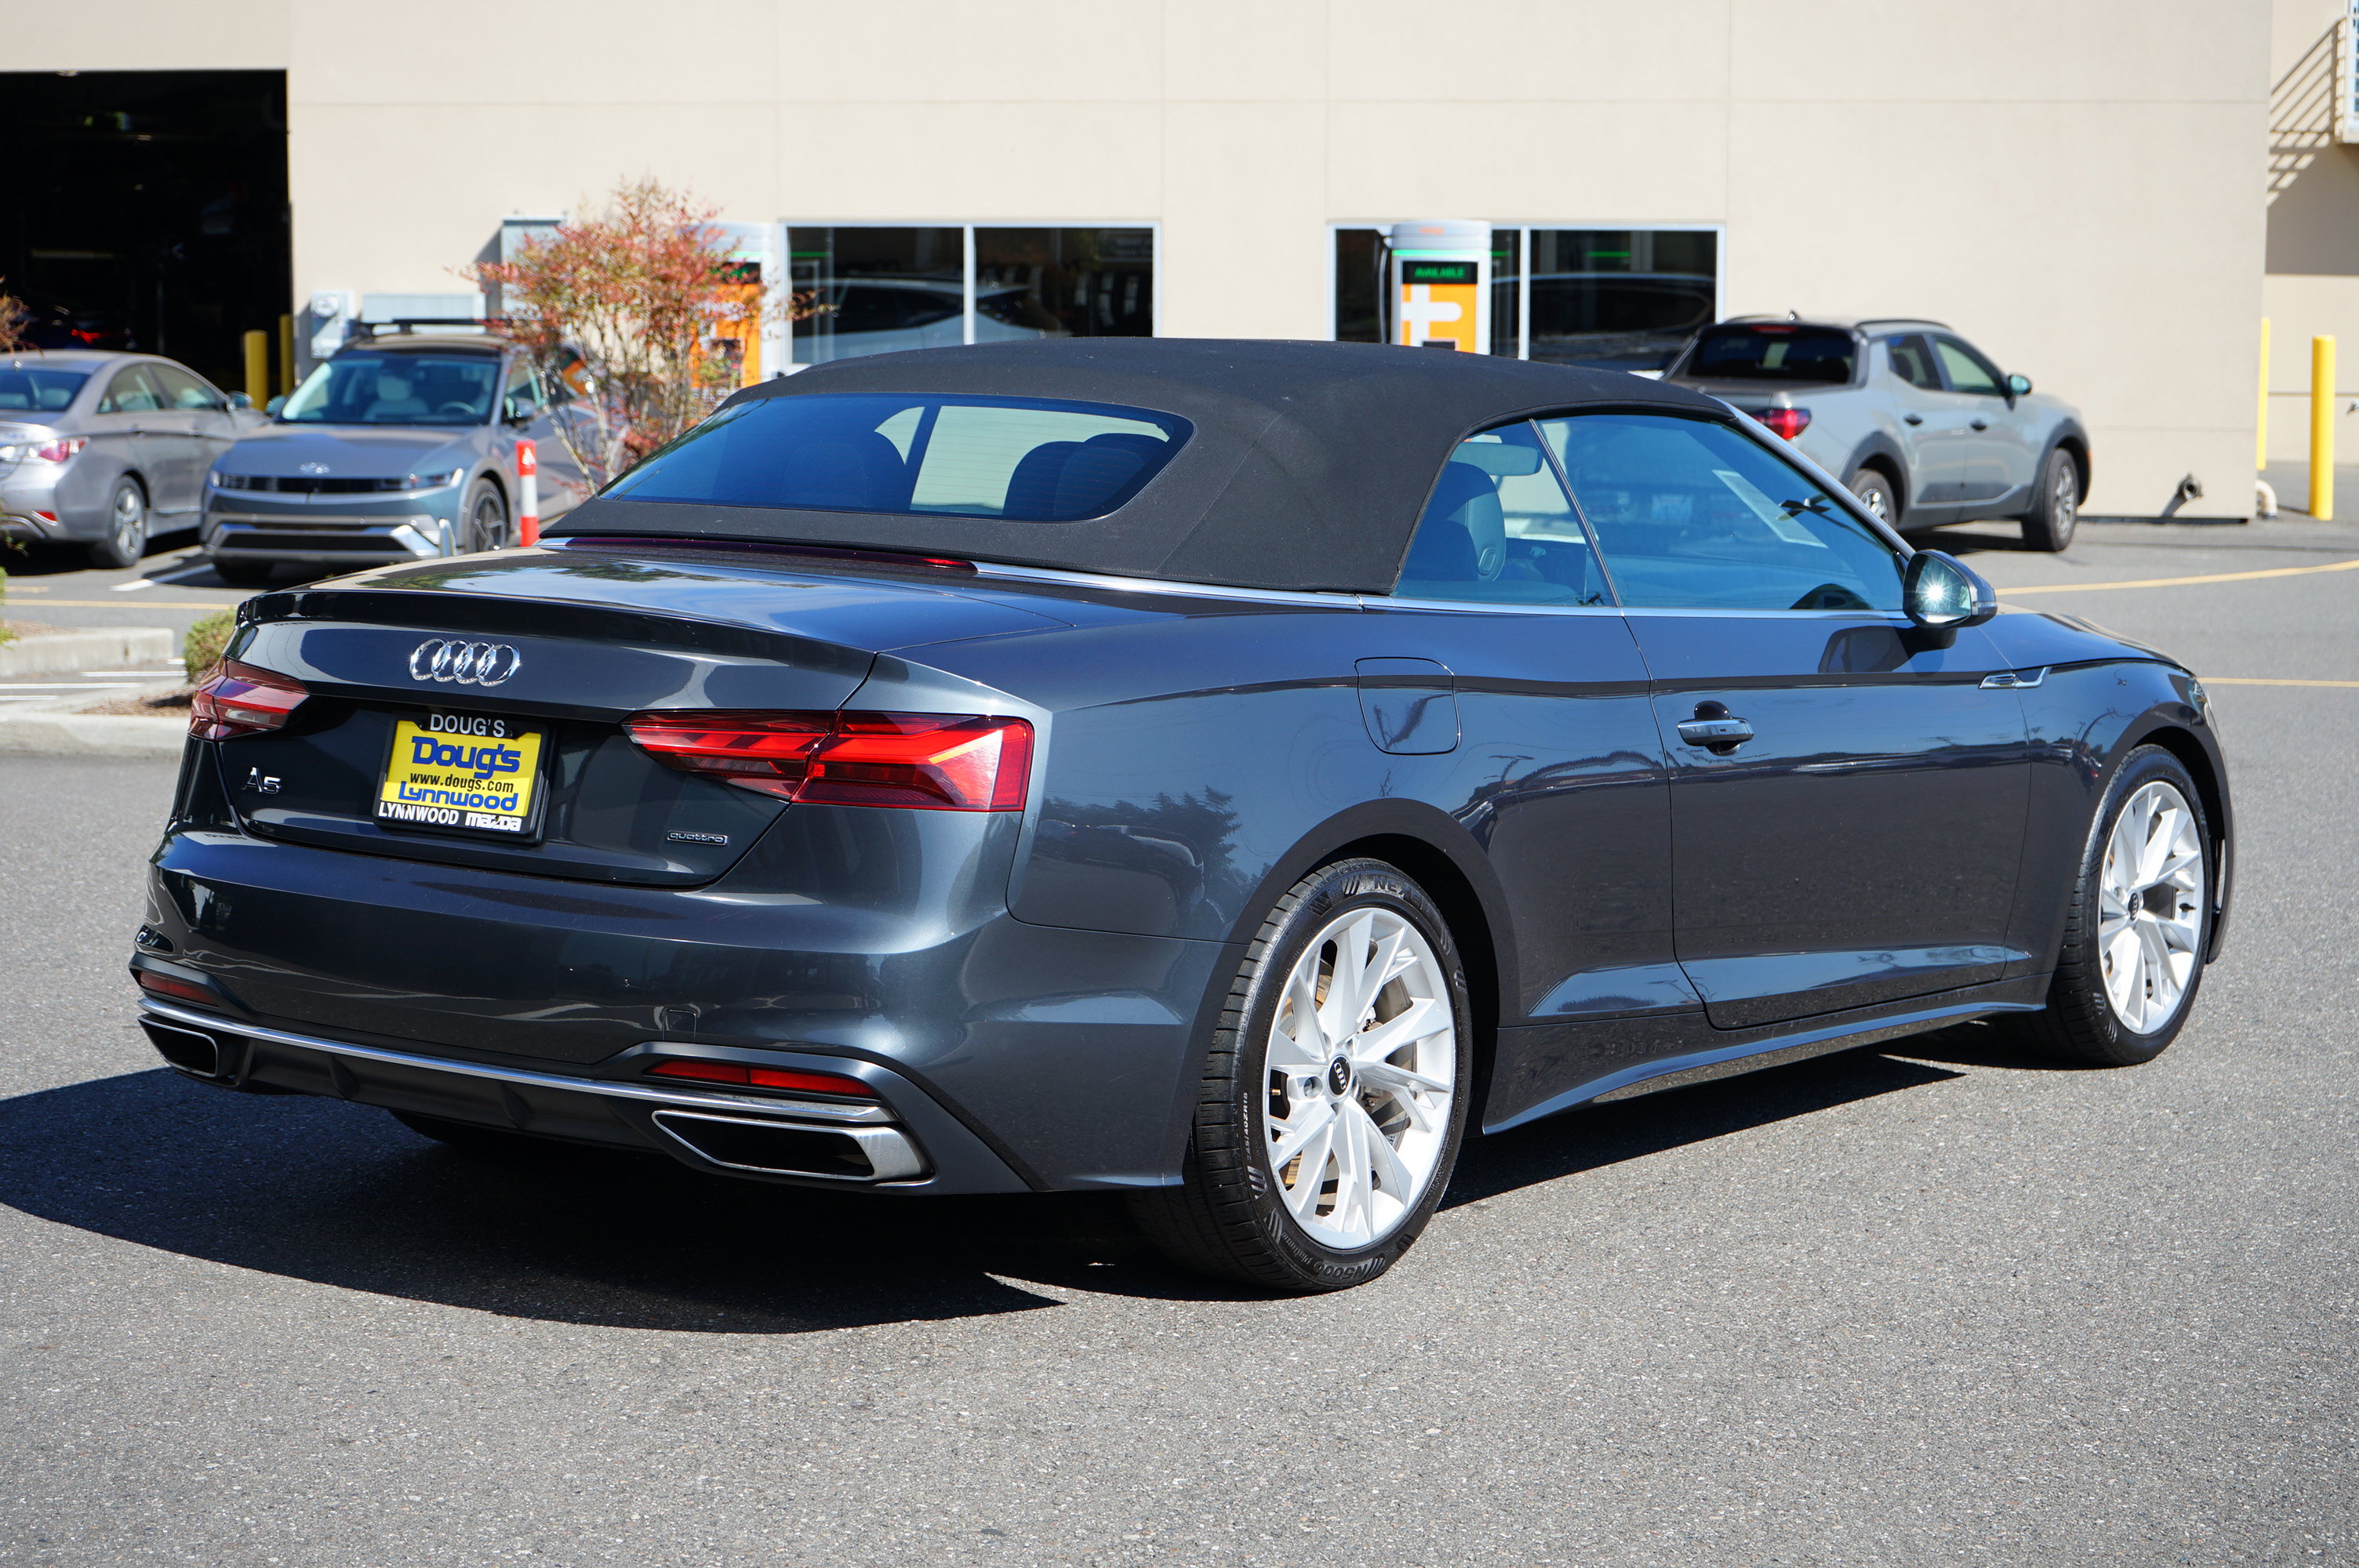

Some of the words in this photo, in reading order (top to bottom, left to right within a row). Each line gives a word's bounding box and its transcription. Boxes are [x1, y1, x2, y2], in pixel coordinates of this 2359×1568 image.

[430, 713, 506, 738] DOUG'S
[241, 767, 282, 794] A5
[410, 772, 514, 793] www.dougs.com
[398, 781, 518, 811] Lynnwood
[378, 802, 459, 826] LYNNWOOD
[670, 833, 724, 843] quattro
[1314, 1261, 1368, 1279] N5000
